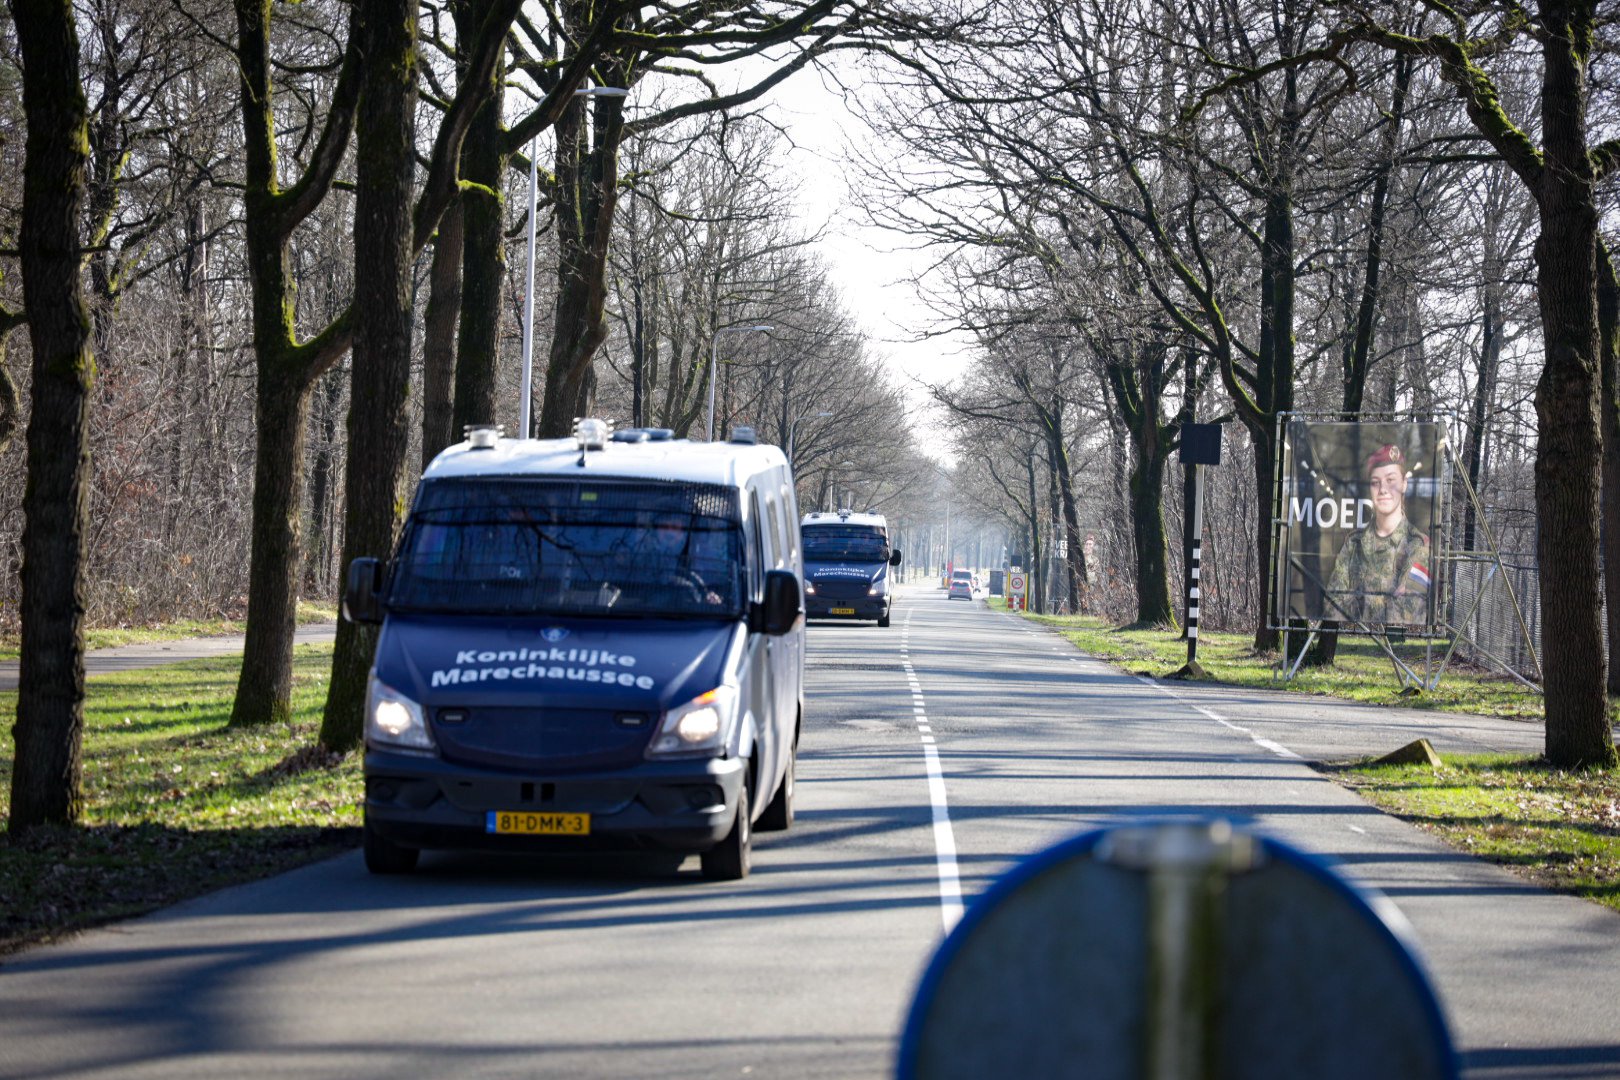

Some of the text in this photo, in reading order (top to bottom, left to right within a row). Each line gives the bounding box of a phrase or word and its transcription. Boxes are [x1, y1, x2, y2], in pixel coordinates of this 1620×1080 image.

[1288, 497, 1373, 528] MOED
[456, 648, 636, 667] Koninklijke
[431, 663, 654, 689] Marechaussee
[501, 814, 583, 832] 81-DMK-3
